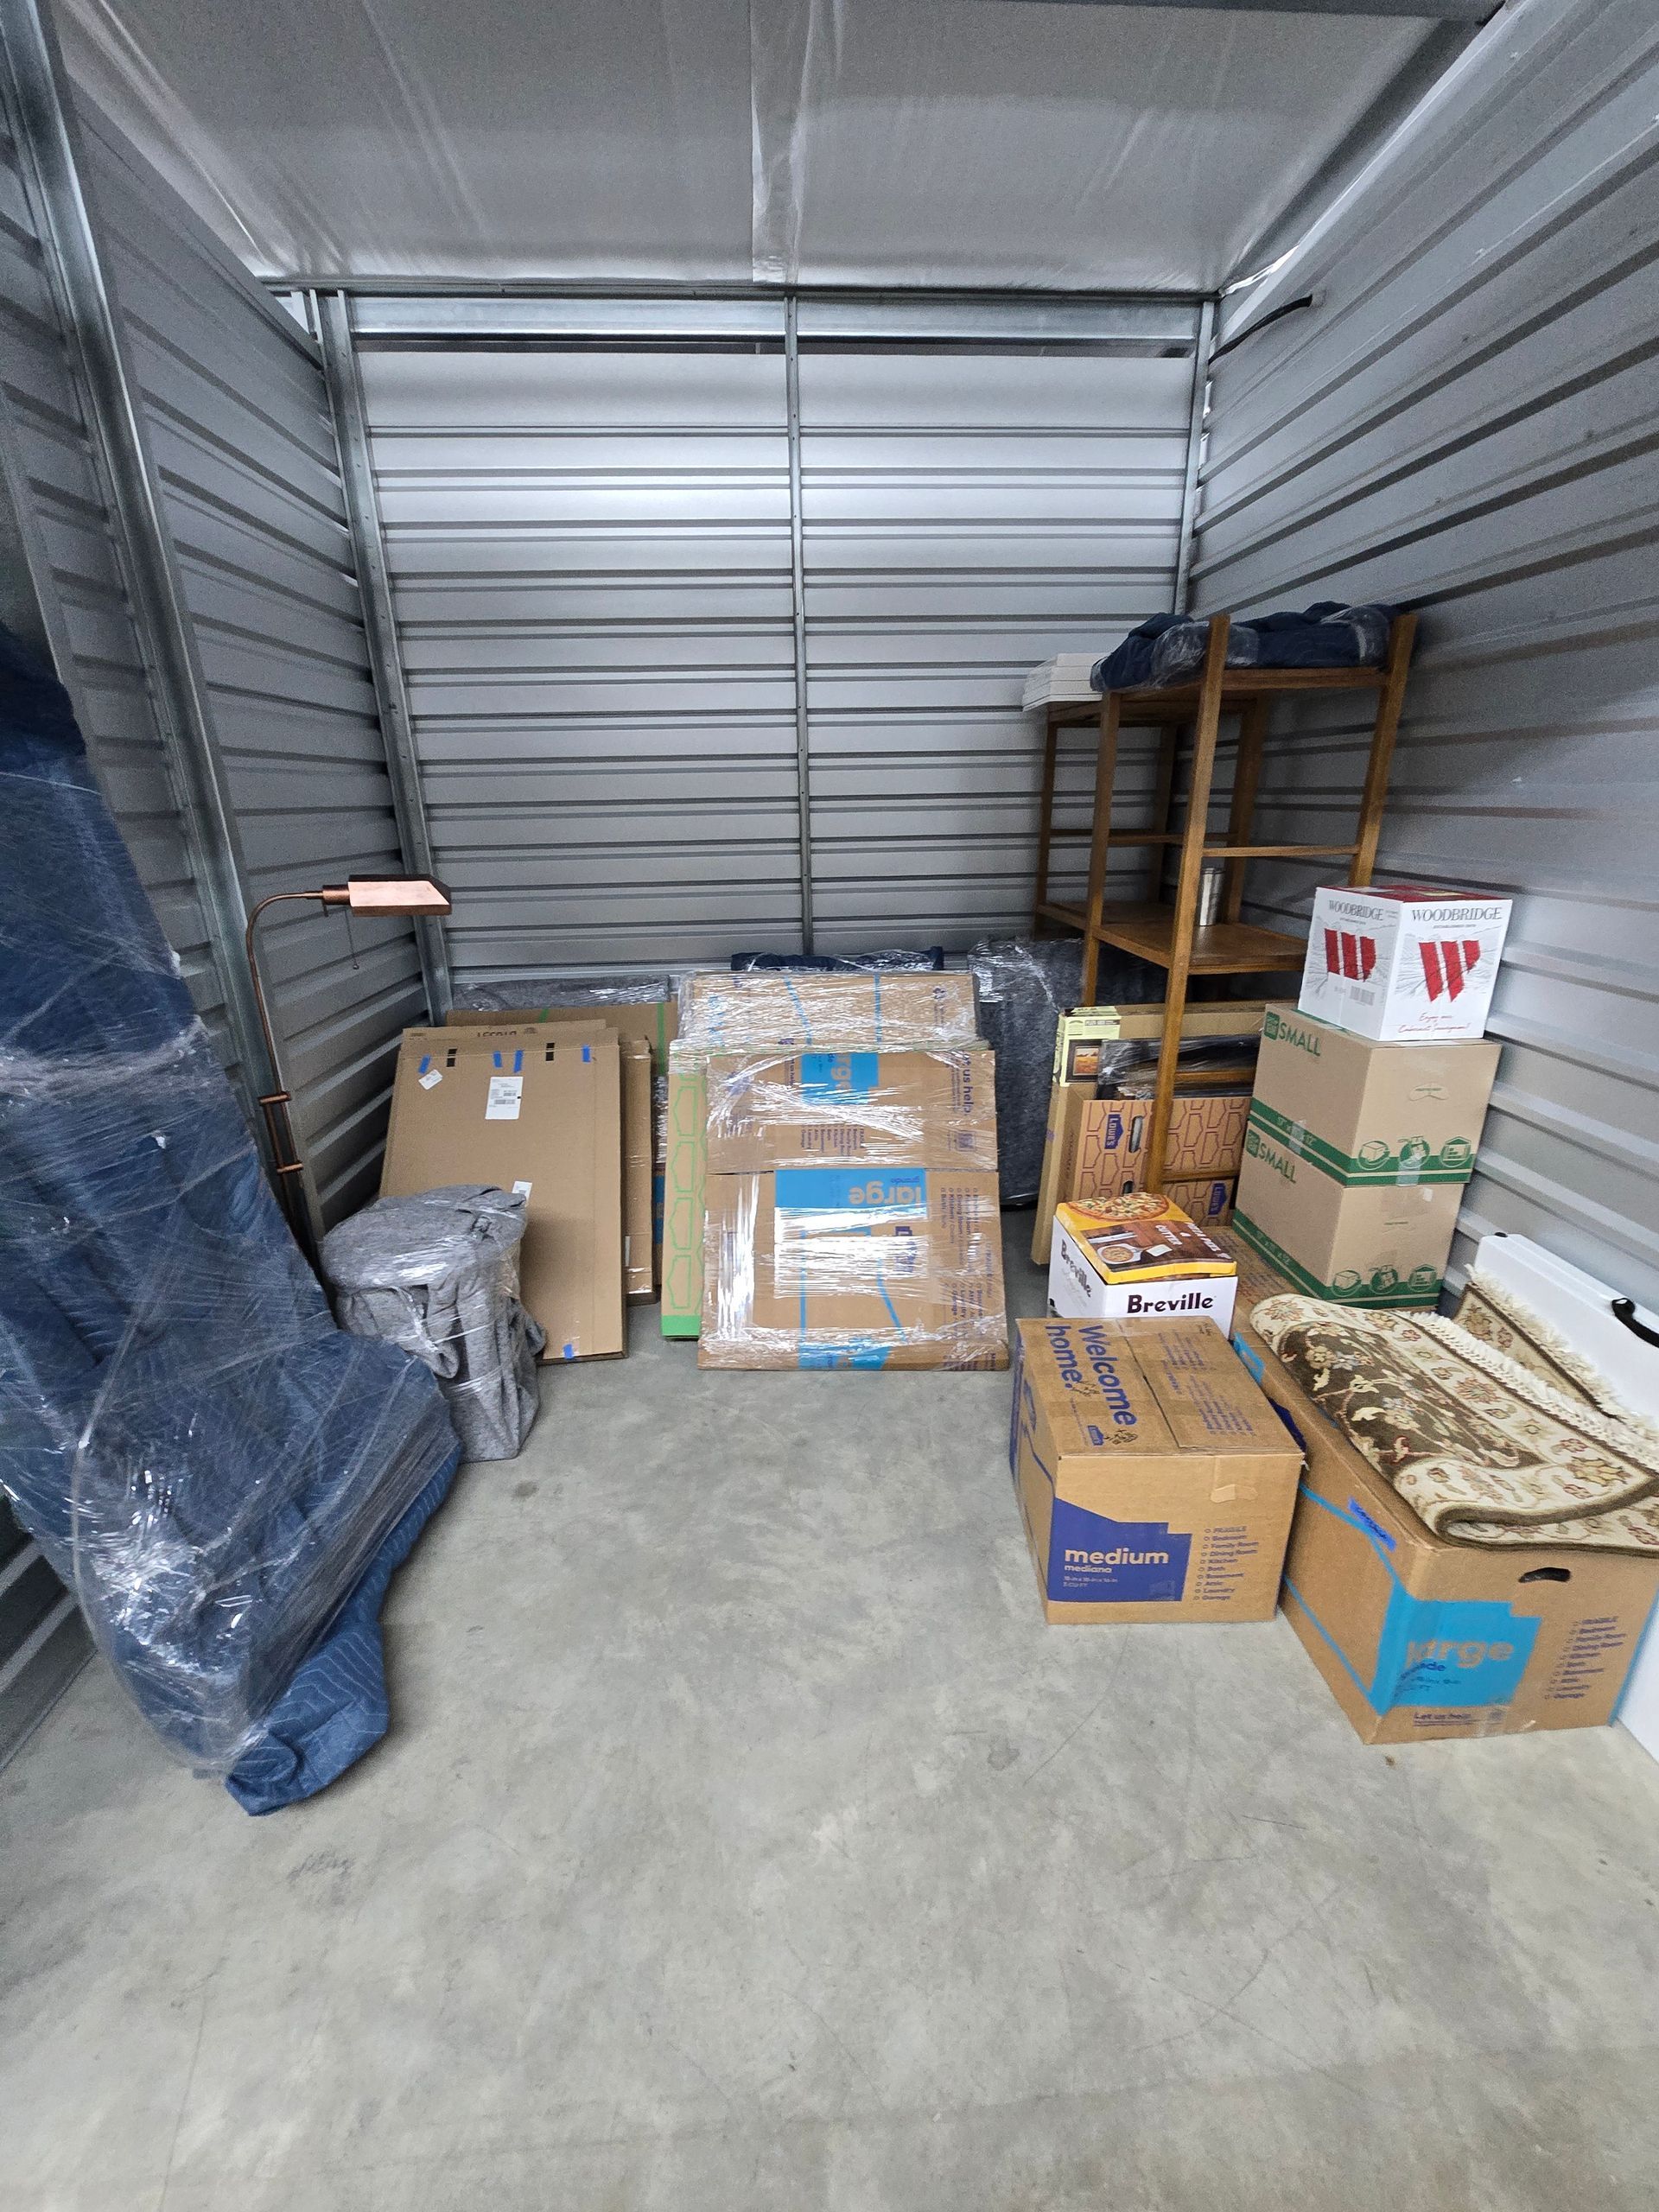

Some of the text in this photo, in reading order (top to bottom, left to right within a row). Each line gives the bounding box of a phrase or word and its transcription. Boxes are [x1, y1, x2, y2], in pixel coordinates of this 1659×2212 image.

[1329, 899, 1383, 921] WOODBRIDGE
[1412, 906, 1503, 922] WOODBRIDGE
[1279, 1022, 1321, 1057] SMALL
[1259, 1142, 1296, 1184] SMALL
[1154, 1224, 1183, 1245] CUTTER
[1061, 1238, 1092, 1297] Breville
[1127, 1292, 1214, 1314] Breville
[1044, 1325, 1084, 1389] home.
[1077, 1325, 1138, 1426] Welcome
[1064, 1547, 1170, 1566] medium
